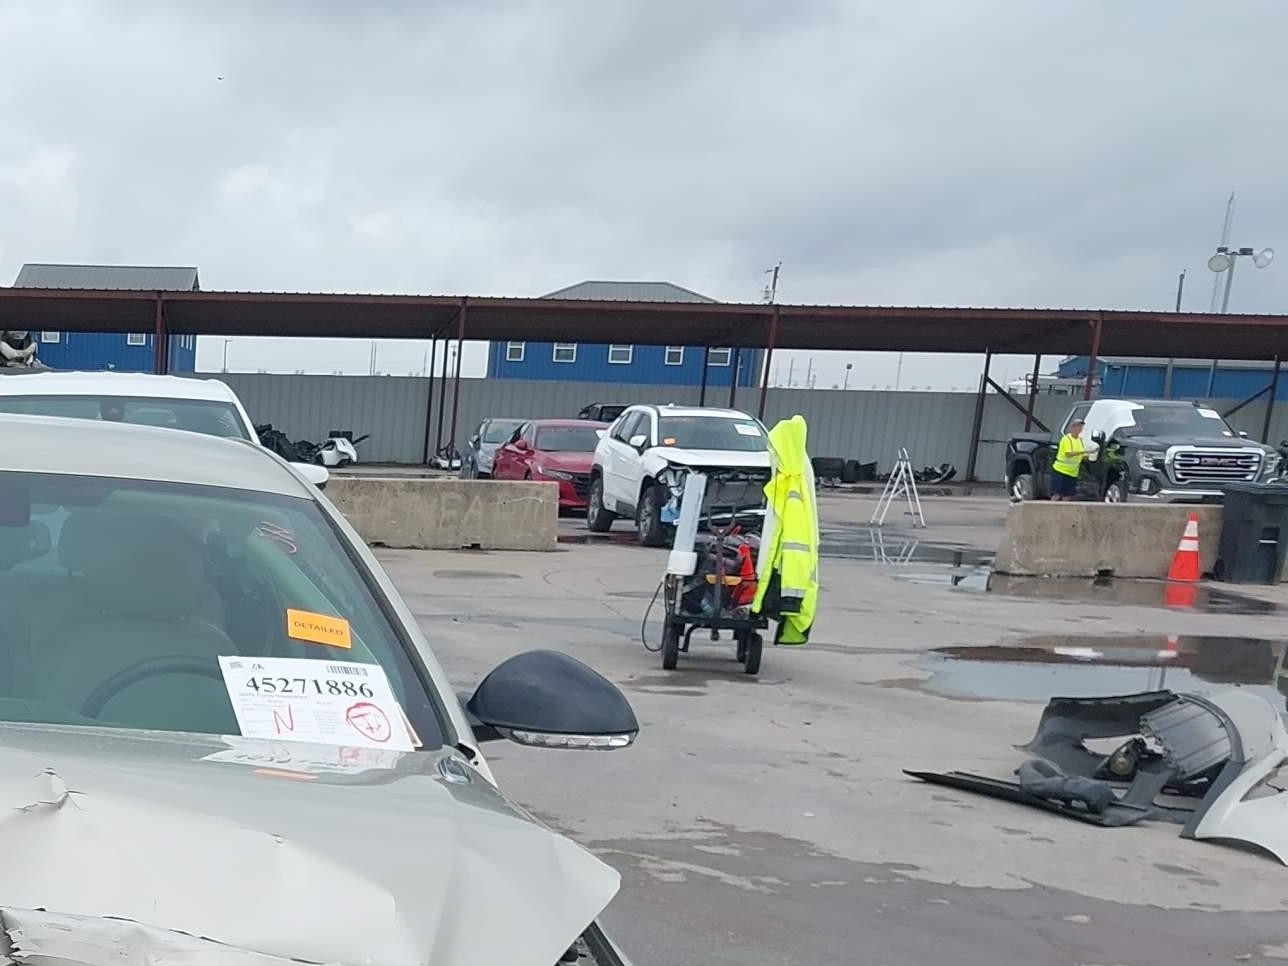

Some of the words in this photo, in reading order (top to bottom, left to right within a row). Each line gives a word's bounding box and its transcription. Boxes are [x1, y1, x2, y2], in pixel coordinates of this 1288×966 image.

[293, 621, 344, 636] DETAILED
[245, 676, 374, 699] 45271886
[273, 703, 295, 735] N
